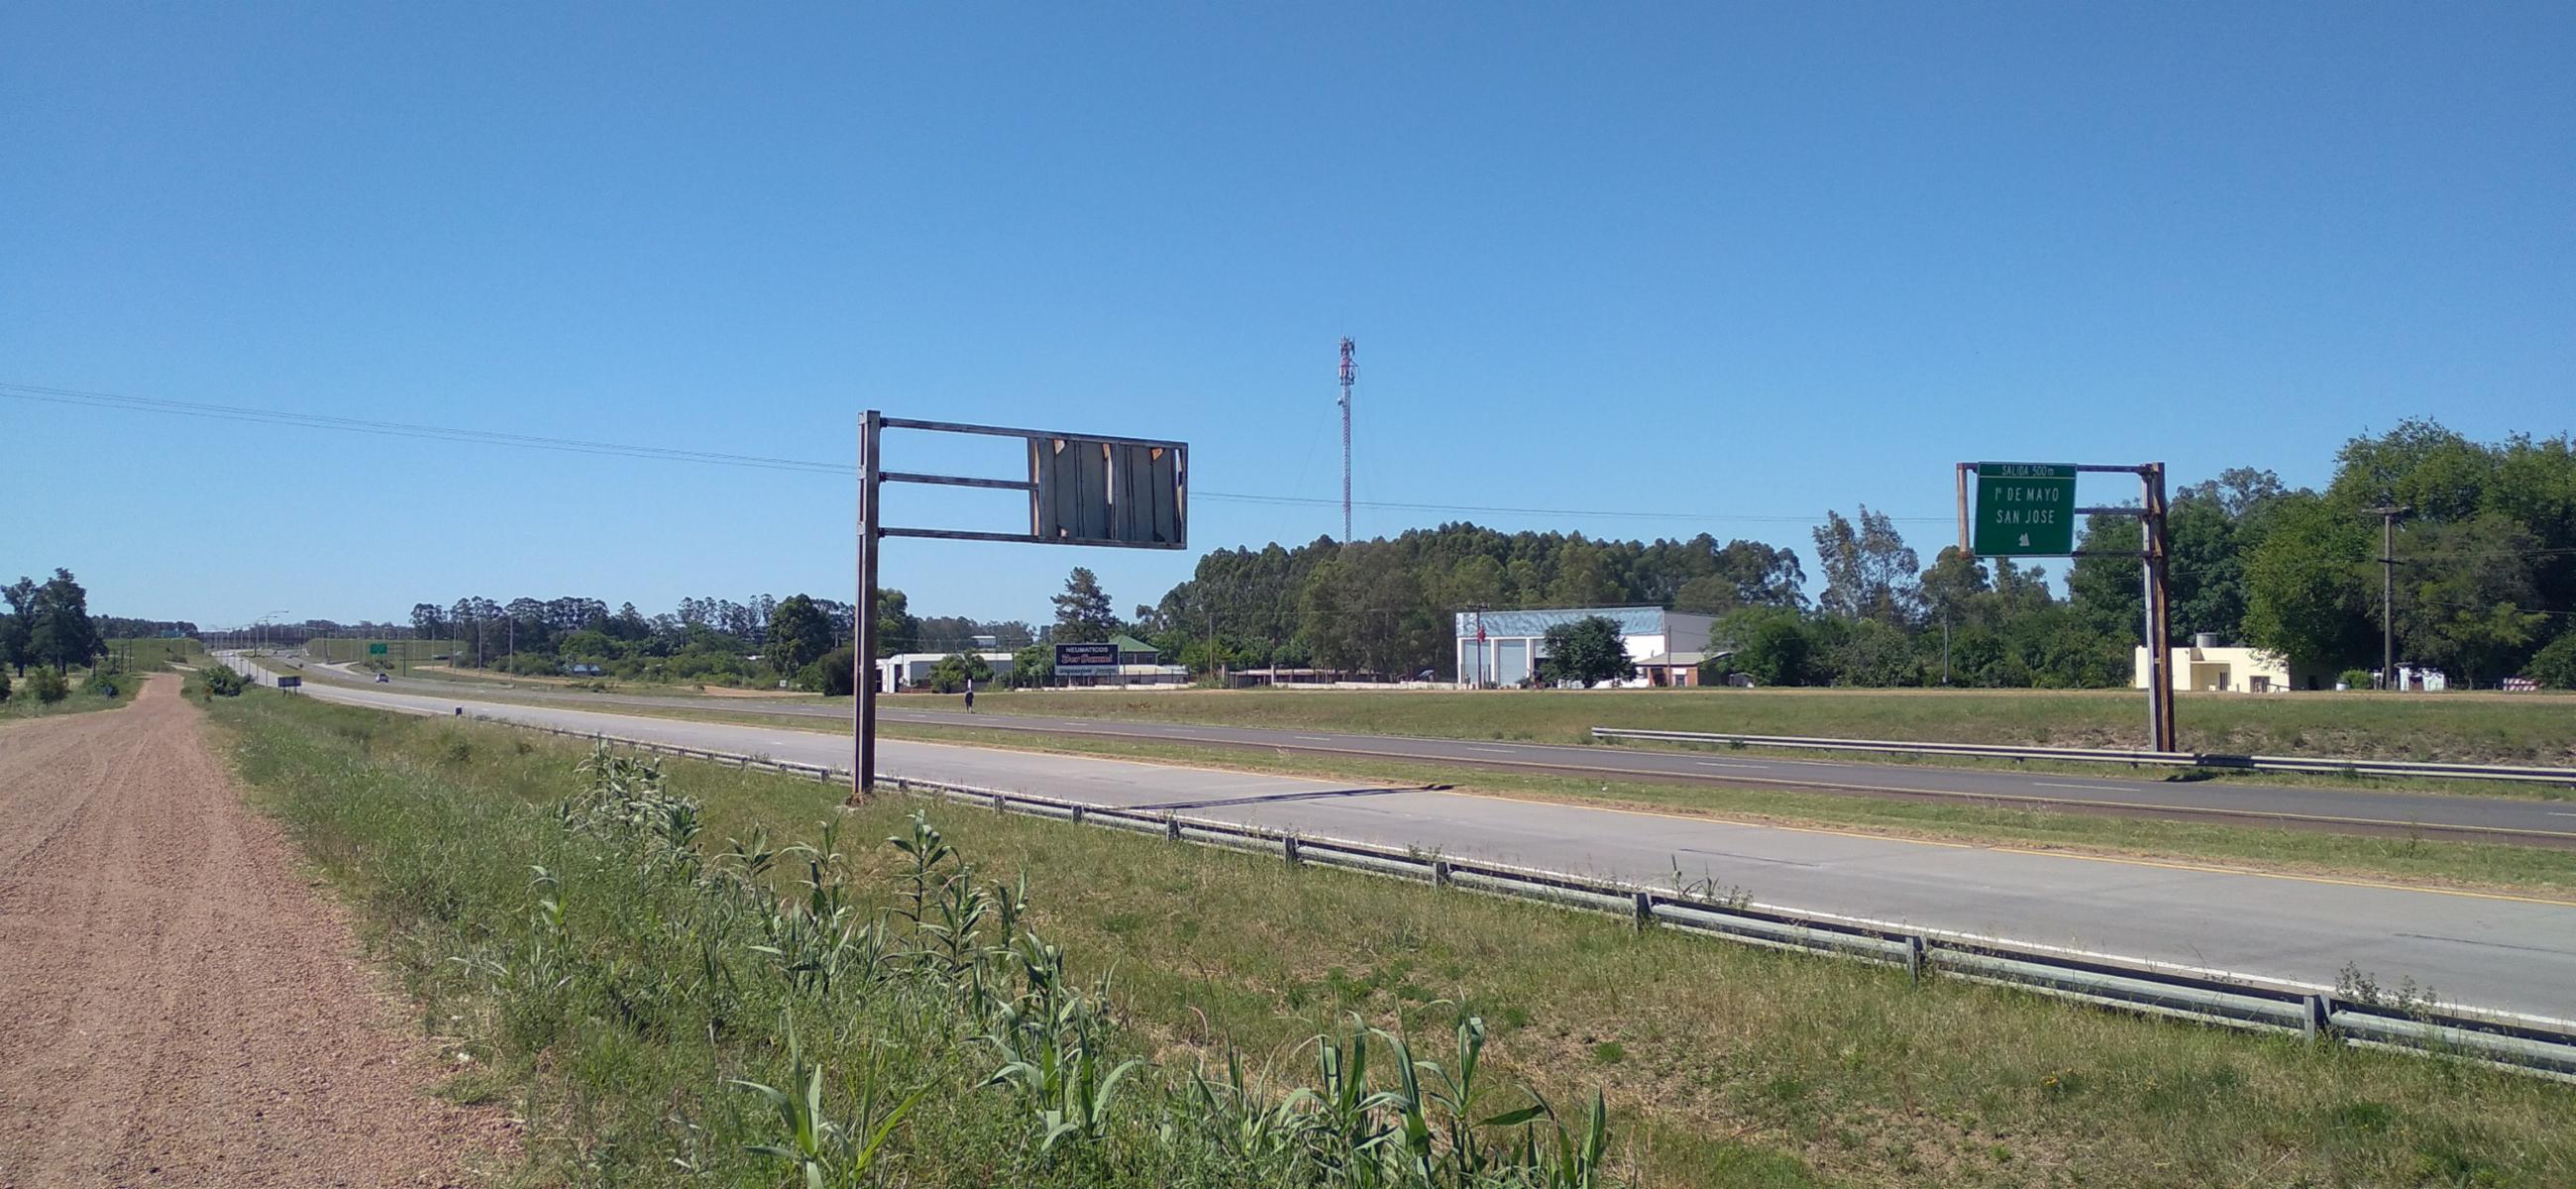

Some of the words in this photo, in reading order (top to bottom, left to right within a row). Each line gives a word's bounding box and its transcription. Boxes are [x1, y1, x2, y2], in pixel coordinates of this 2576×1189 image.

[2002, 465, 2029, 476] SALIDA
[2007, 486, 2022, 501] DE
[2026, 487, 2059, 501] MAYO
[1996, 509, 2020, 524] SAN
[2025, 509, 2055, 524] JOSE
